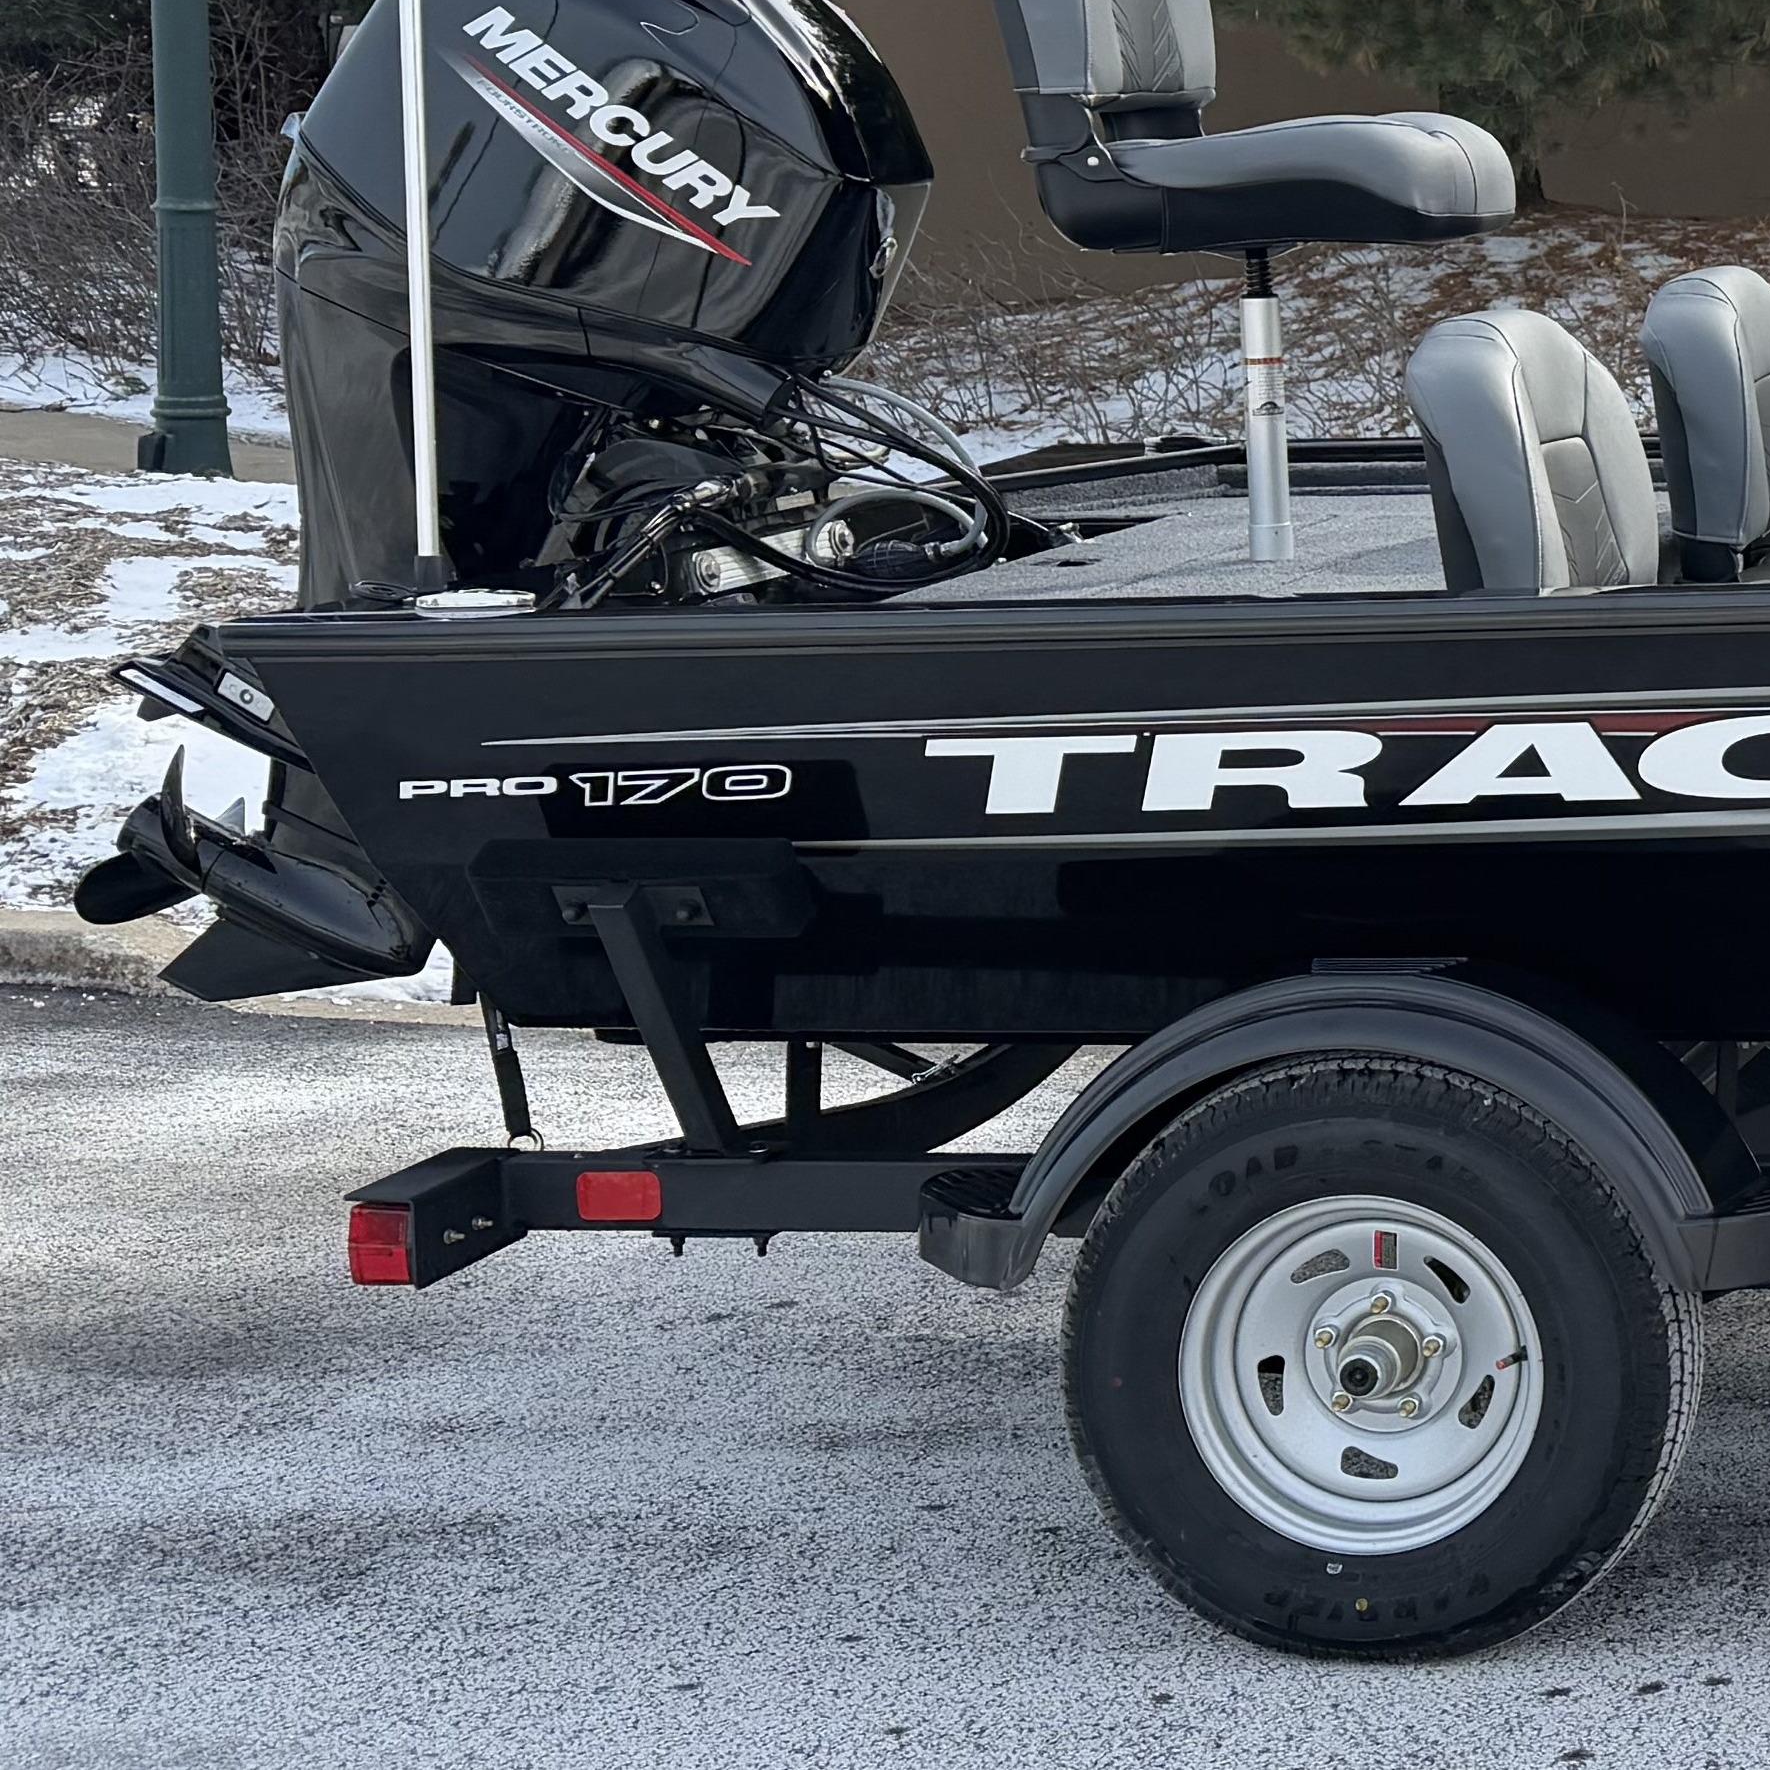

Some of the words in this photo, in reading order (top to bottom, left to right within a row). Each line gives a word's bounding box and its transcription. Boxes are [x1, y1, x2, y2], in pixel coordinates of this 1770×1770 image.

[461, 5, 782, 229] MERCURY
[476, 78, 570, 154] FOURSTROKE
[399, 776, 557, 800] PRO
[569, 764, 792, 807] 170
